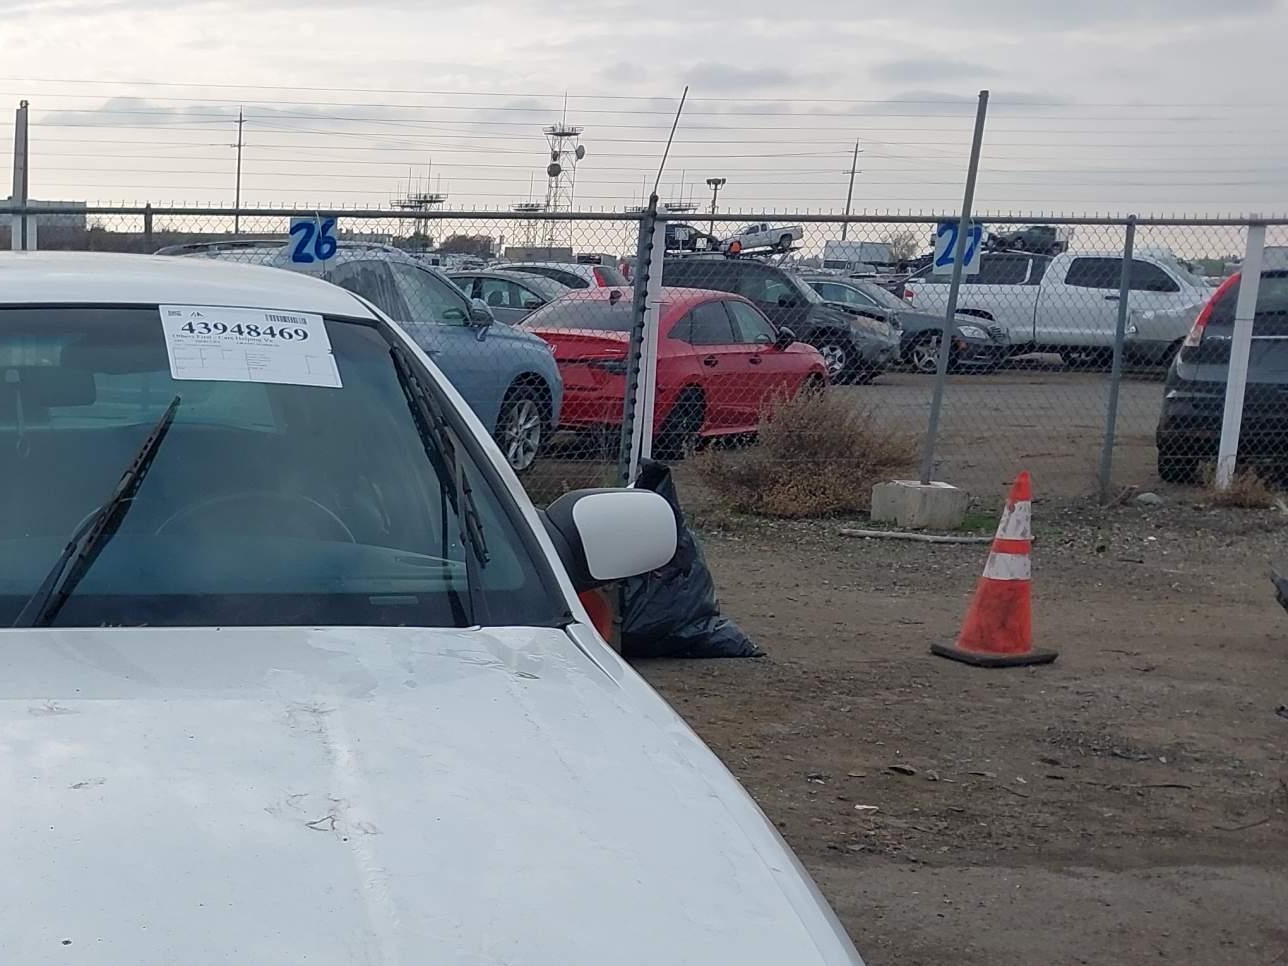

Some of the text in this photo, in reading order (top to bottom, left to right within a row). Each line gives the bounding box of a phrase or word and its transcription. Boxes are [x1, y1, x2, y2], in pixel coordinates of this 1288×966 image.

[290, 217, 337, 263] 26
[936, 223, 982, 267] 27
[181, 320, 309, 342] 43948469
